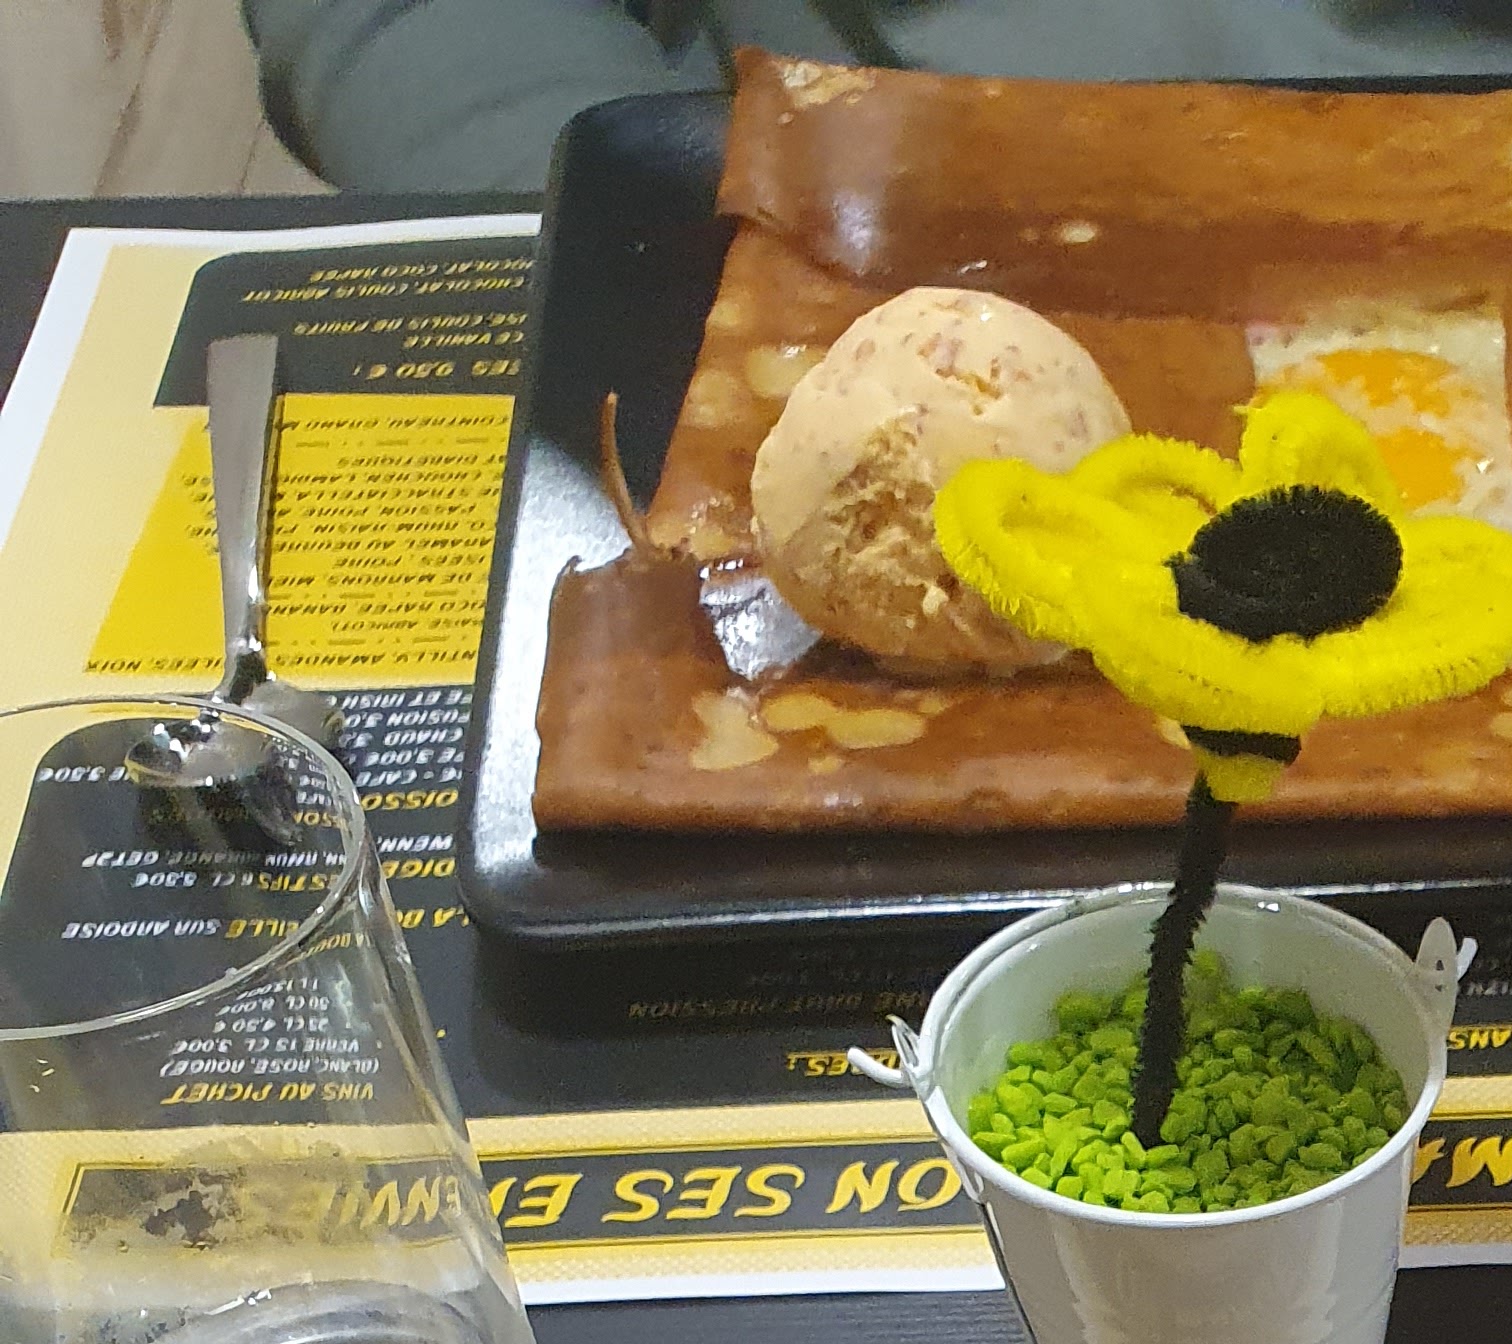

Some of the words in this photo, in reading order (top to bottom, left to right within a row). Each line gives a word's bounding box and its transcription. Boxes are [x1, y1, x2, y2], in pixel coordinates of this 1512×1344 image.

[60, 919, 171, 940] ARDOISE
[159, 1082, 274, 1106] PICHET
[278, 1082, 317, 1102] AU
[320, 1082, 374, 1102] VINS
[599, 1163, 806, 1224] SES
[825, 1156, 963, 1215] ON
